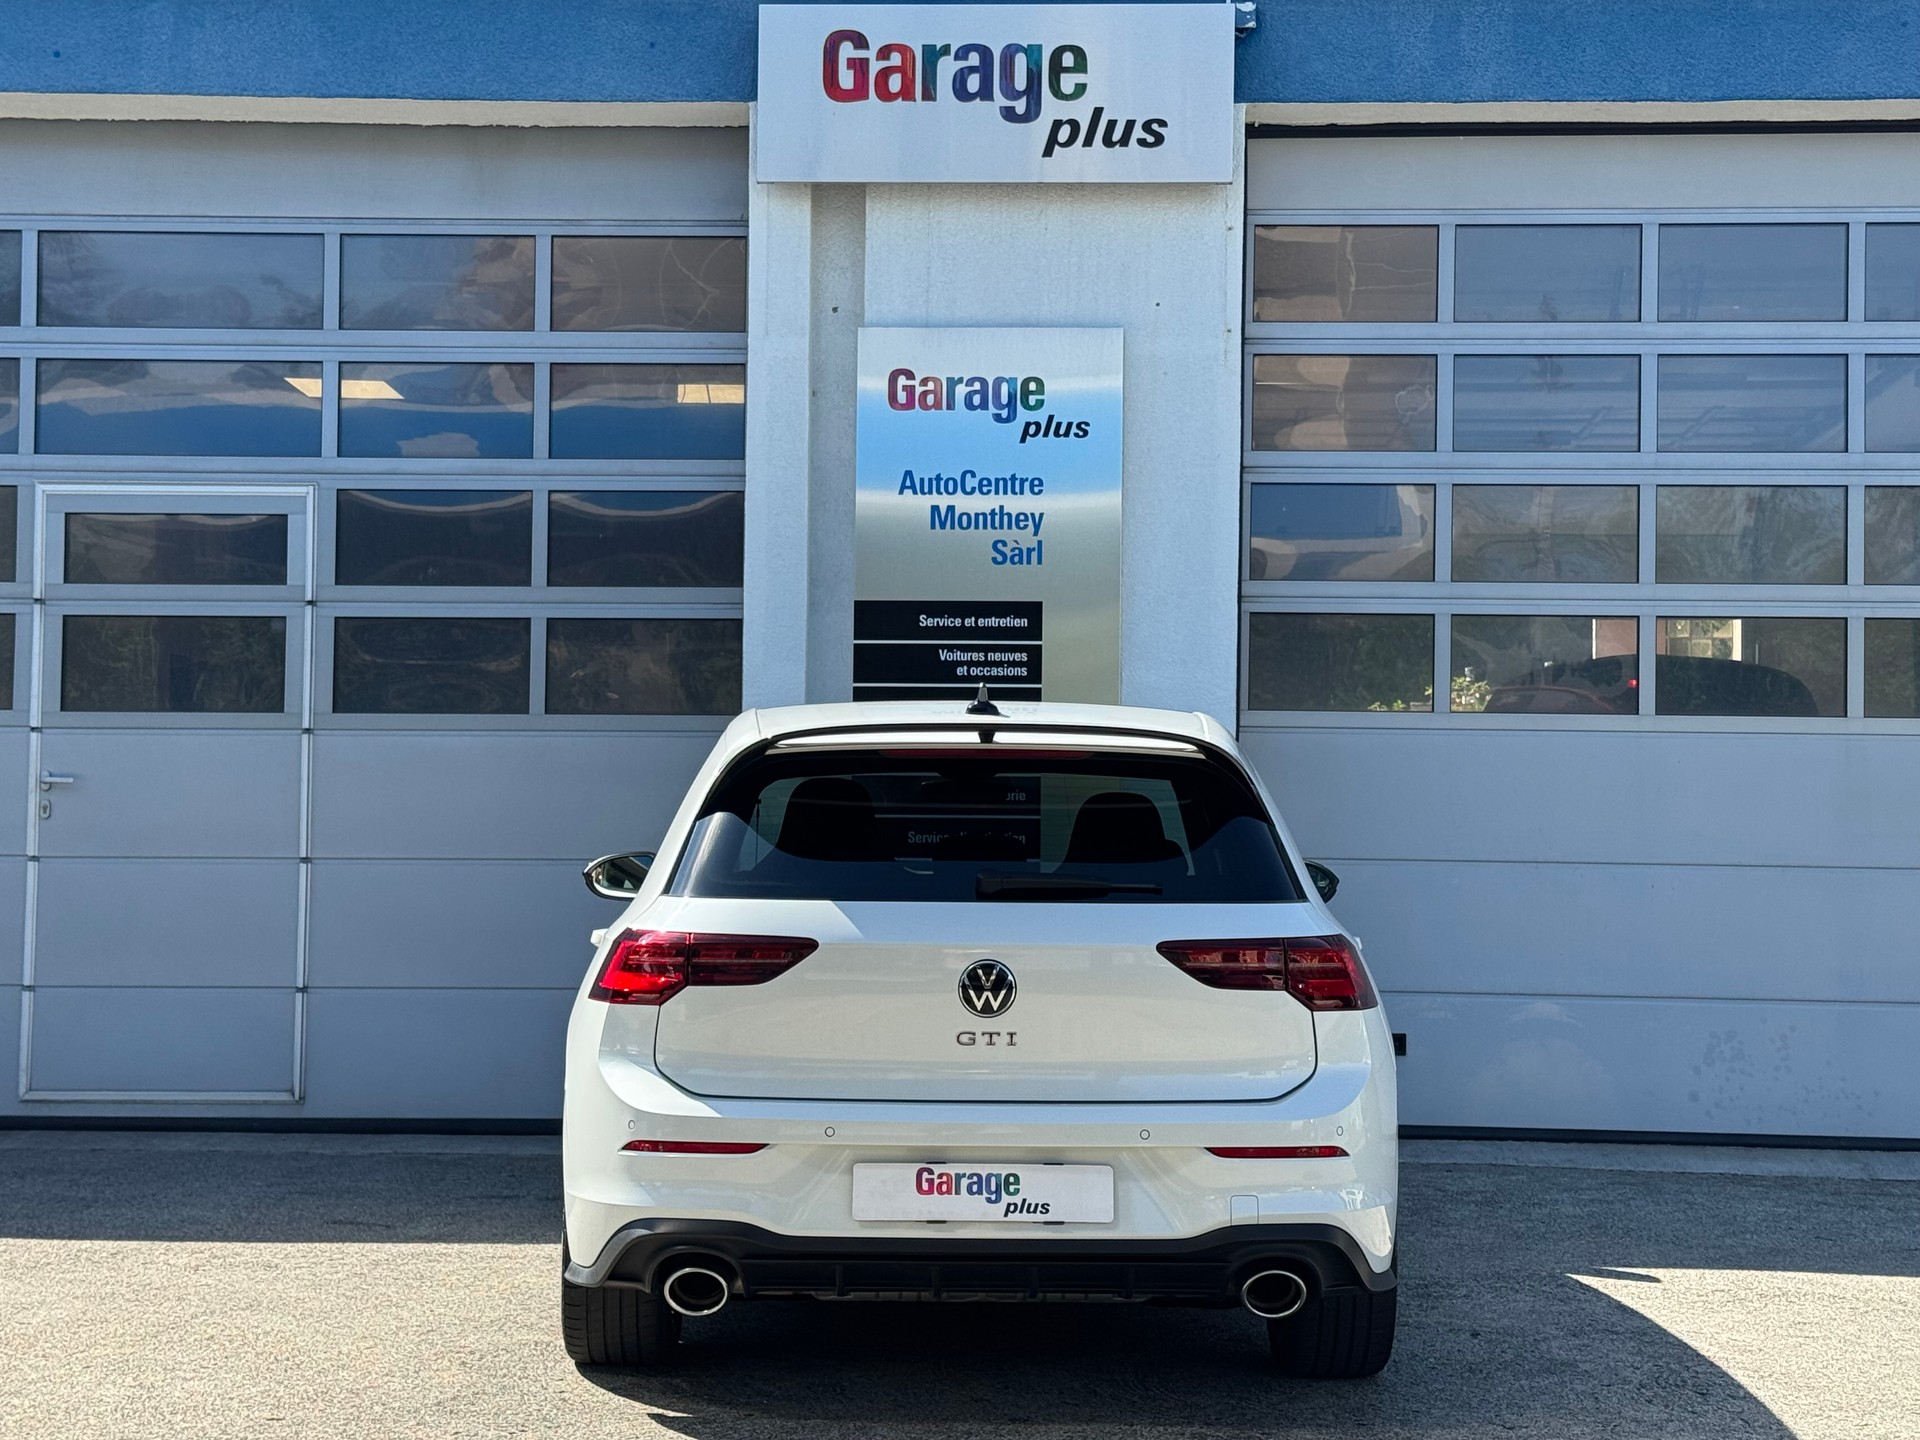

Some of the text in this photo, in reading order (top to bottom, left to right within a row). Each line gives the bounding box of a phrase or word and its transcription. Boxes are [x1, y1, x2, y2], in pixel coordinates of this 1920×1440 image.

[822, 29, 1088, 124] Garage
[1042, 107, 1169, 158] plus
[887, 367, 1046, 424] Garage
[1019, 415, 1091, 443] plus
[898, 469, 1044, 496] AutoCentre
[930, 504, 1044, 537] Monthey
[991, 539, 1043, 566] Sàrl
[919, 615, 1028, 627] Service et entretien
[939, 649, 1028, 662] Voitures neuves
[957, 665, 1028, 676] et occasions
[908, 832, 950, 843] Servic
[956, 1032, 1017, 1046] GTI
[916, 1167, 1021, 1204] Garage
[1003, 1198, 1051, 1217] plus
